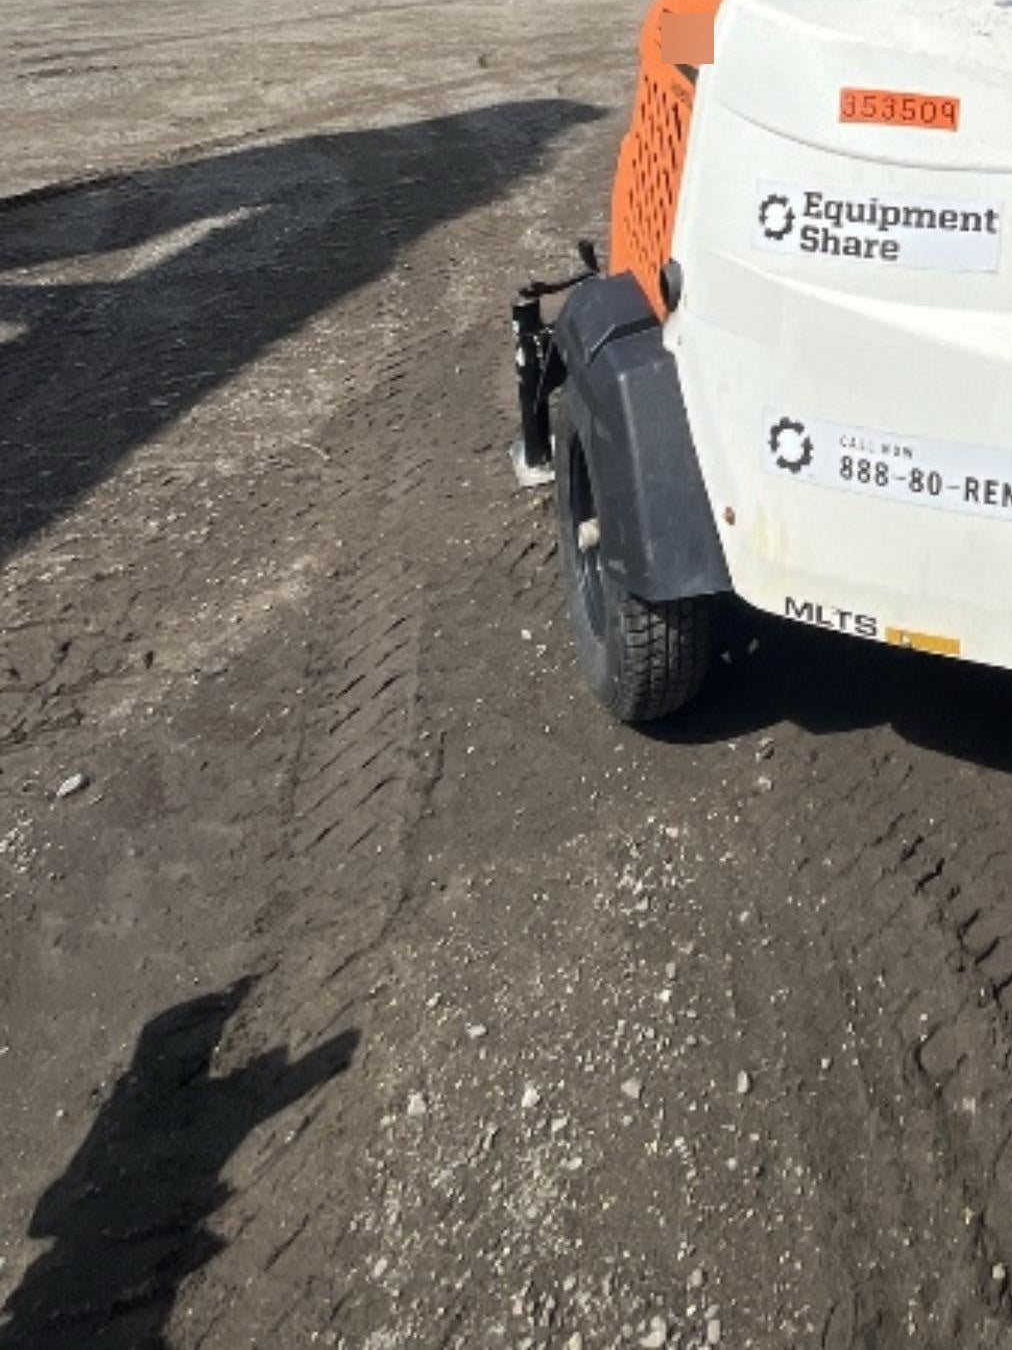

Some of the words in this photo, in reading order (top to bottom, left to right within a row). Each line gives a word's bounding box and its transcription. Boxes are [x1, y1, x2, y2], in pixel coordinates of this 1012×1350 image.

[842, 94, 956, 125] 353509
[803, 191, 999, 234] Equipment
[800, 225, 900, 261] Share
